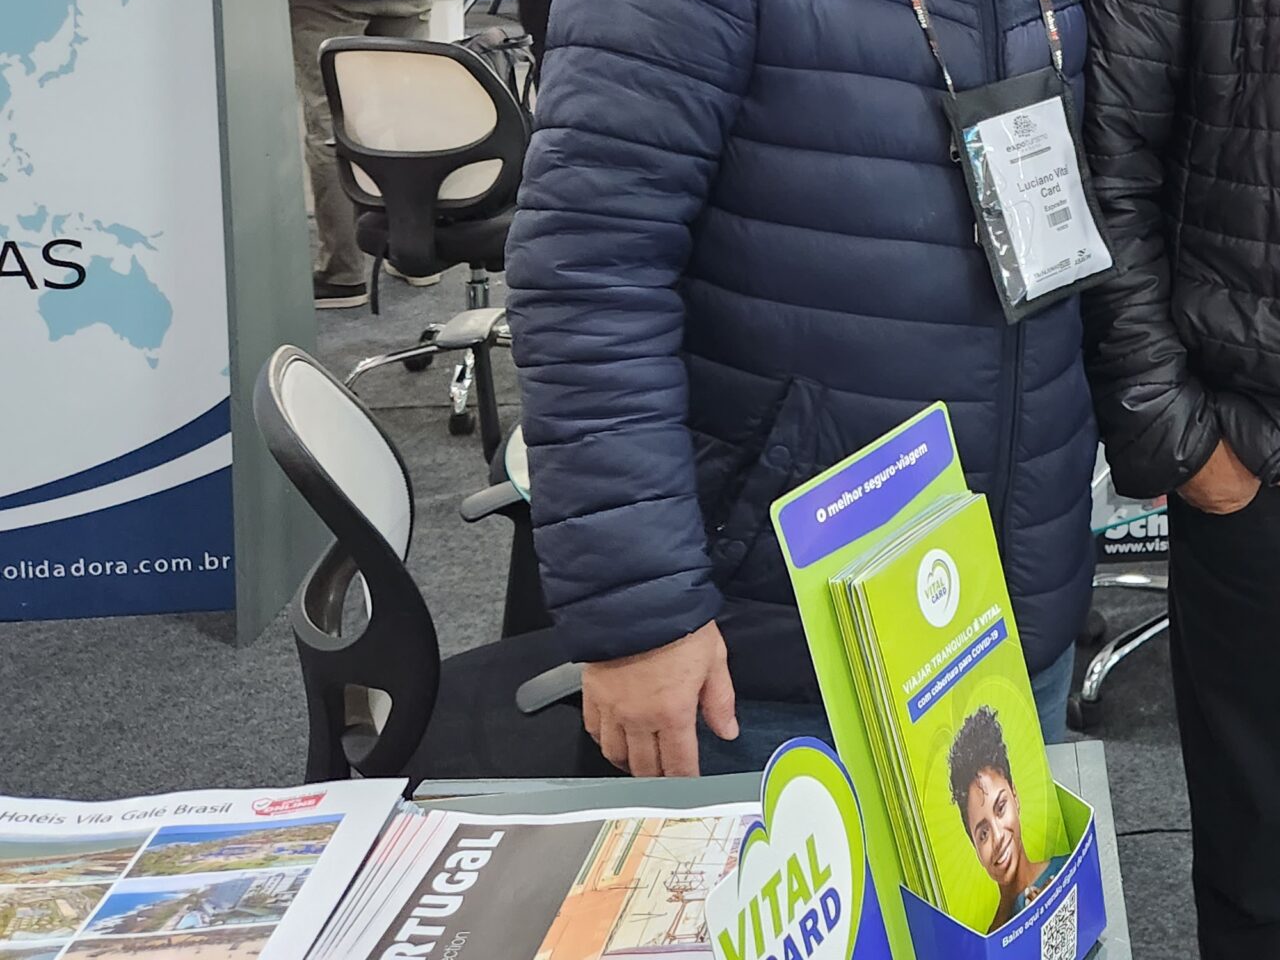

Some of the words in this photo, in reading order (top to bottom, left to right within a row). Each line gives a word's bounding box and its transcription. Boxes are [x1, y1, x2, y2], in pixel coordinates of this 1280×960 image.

[1017, 173, 1054, 193] Luciano
[1040, 182, 1062, 198] Card
[816, 507, 827, 522] O
[827, 485, 863, 517] melhor
[863, 442, 929, 493] seguro-viagem
[924, 576, 945, 600] VITAL
[931, 586, 947, 604] CARD
[902, 663, 932, 694] VIAJAR
[930, 625, 973, 669] TRANQUILO
[978, 603, 1002, 626] VITAL
[917, 692, 932, 709] com
[931, 665, 959, 696] cobertura
[957, 654, 973, 672] para
[971, 629, 999, 659] COVID-19
[0, 811, 67, 825] Hotéis
[77, 814, 113, 825] Vila
[121, 809, 167, 822] Galé
[173, 803, 233, 816] Brasil
[717, 833, 832, 960] VITAL
[766, 887, 841, 960] ARD
[442, 931, 471, 960] ction
